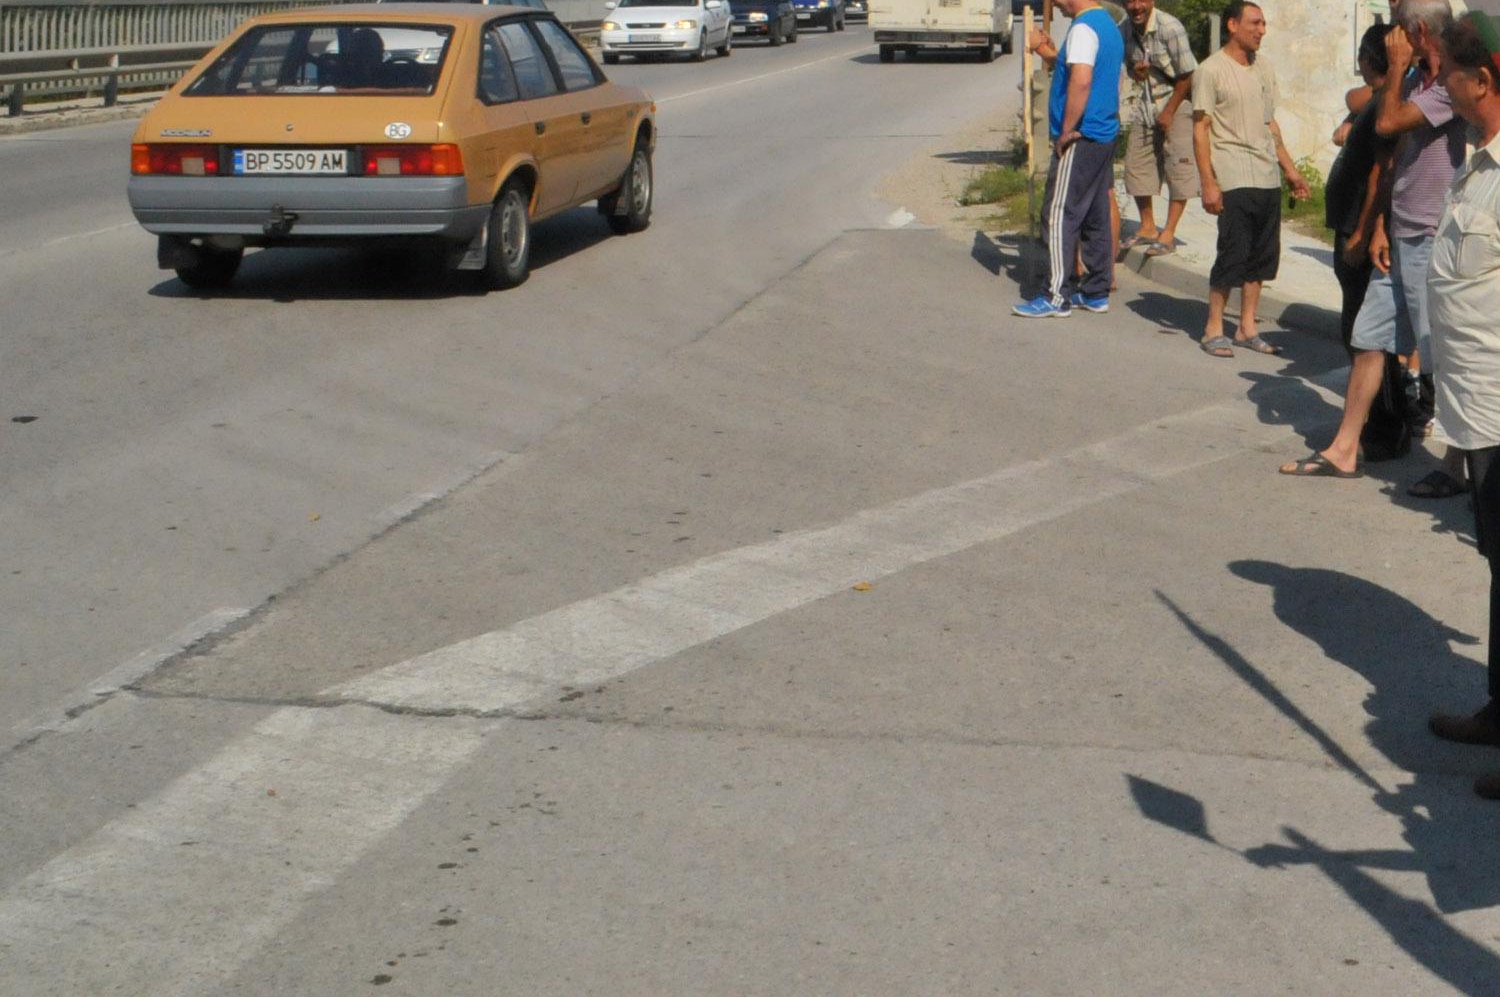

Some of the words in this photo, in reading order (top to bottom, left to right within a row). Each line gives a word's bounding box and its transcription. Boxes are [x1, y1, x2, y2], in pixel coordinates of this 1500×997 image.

[389, 124, 407, 137] BG
[273, 153, 316, 170] 5509
[321, 153, 344, 170] AM
